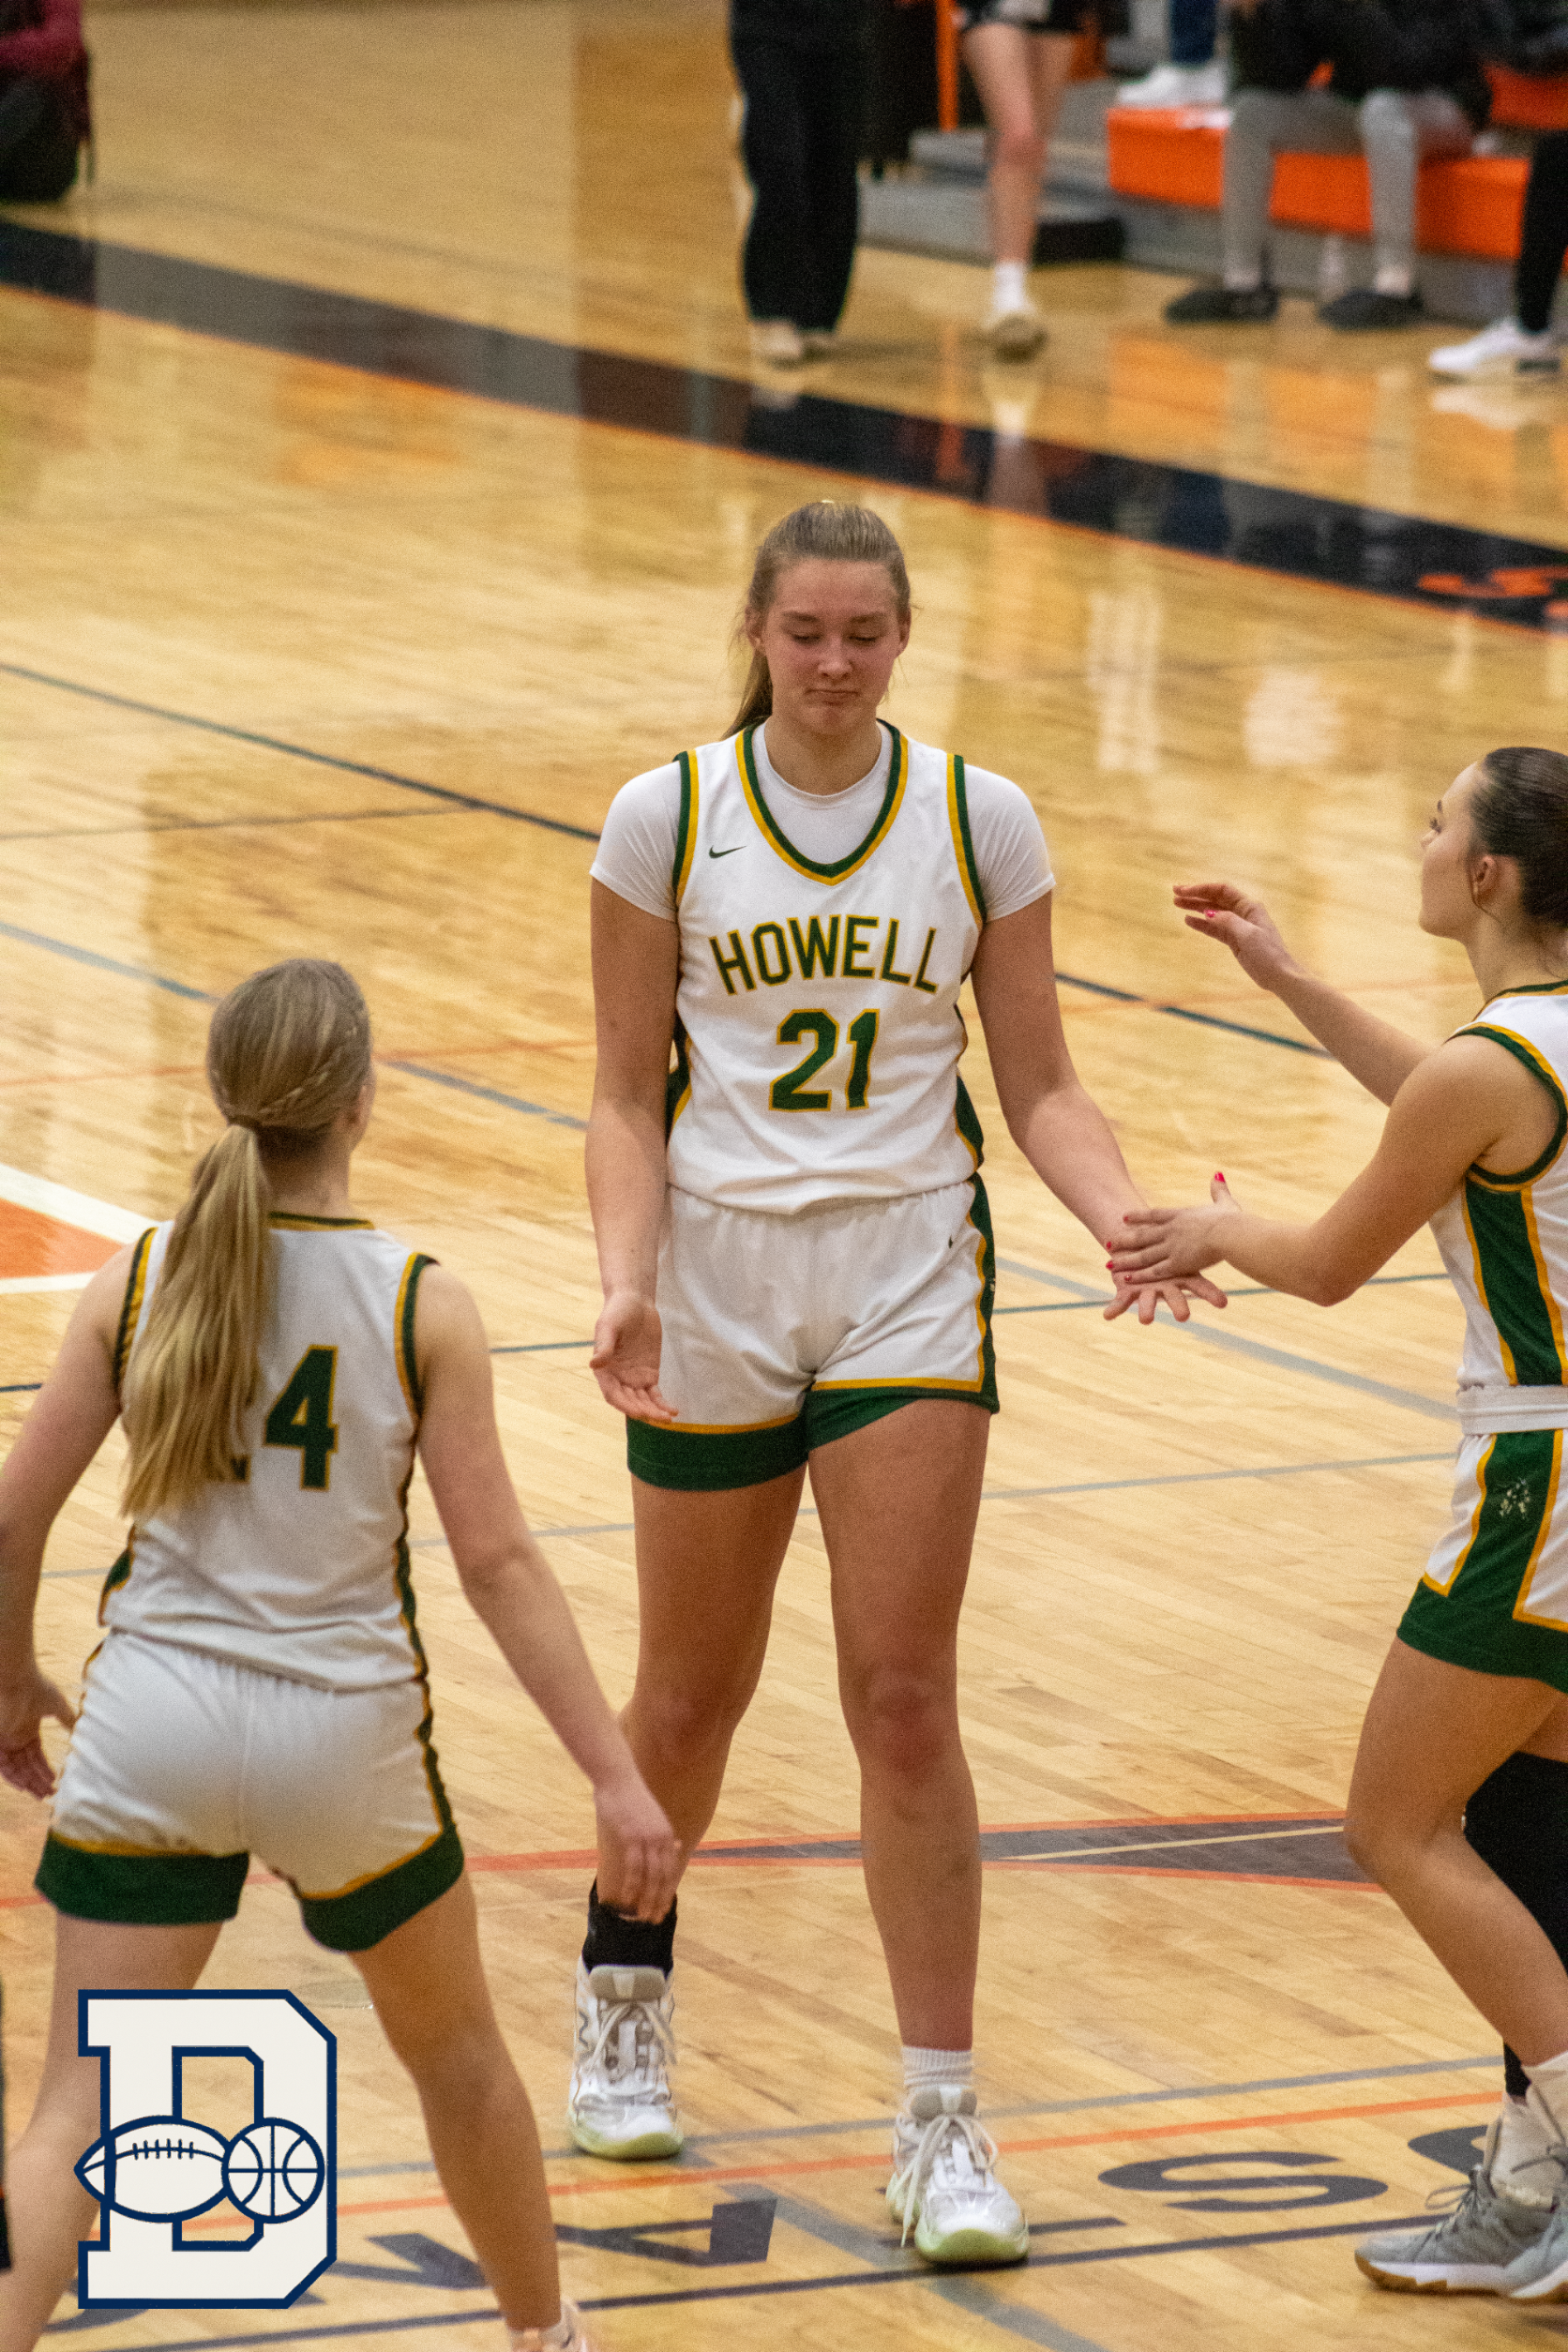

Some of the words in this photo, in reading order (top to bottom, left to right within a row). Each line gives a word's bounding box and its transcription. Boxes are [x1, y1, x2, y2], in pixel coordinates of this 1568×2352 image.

[708, 914, 939, 996] HOWELL
[768, 1008, 881, 1112] 21
[223, 1344, 339, 1492] 4
